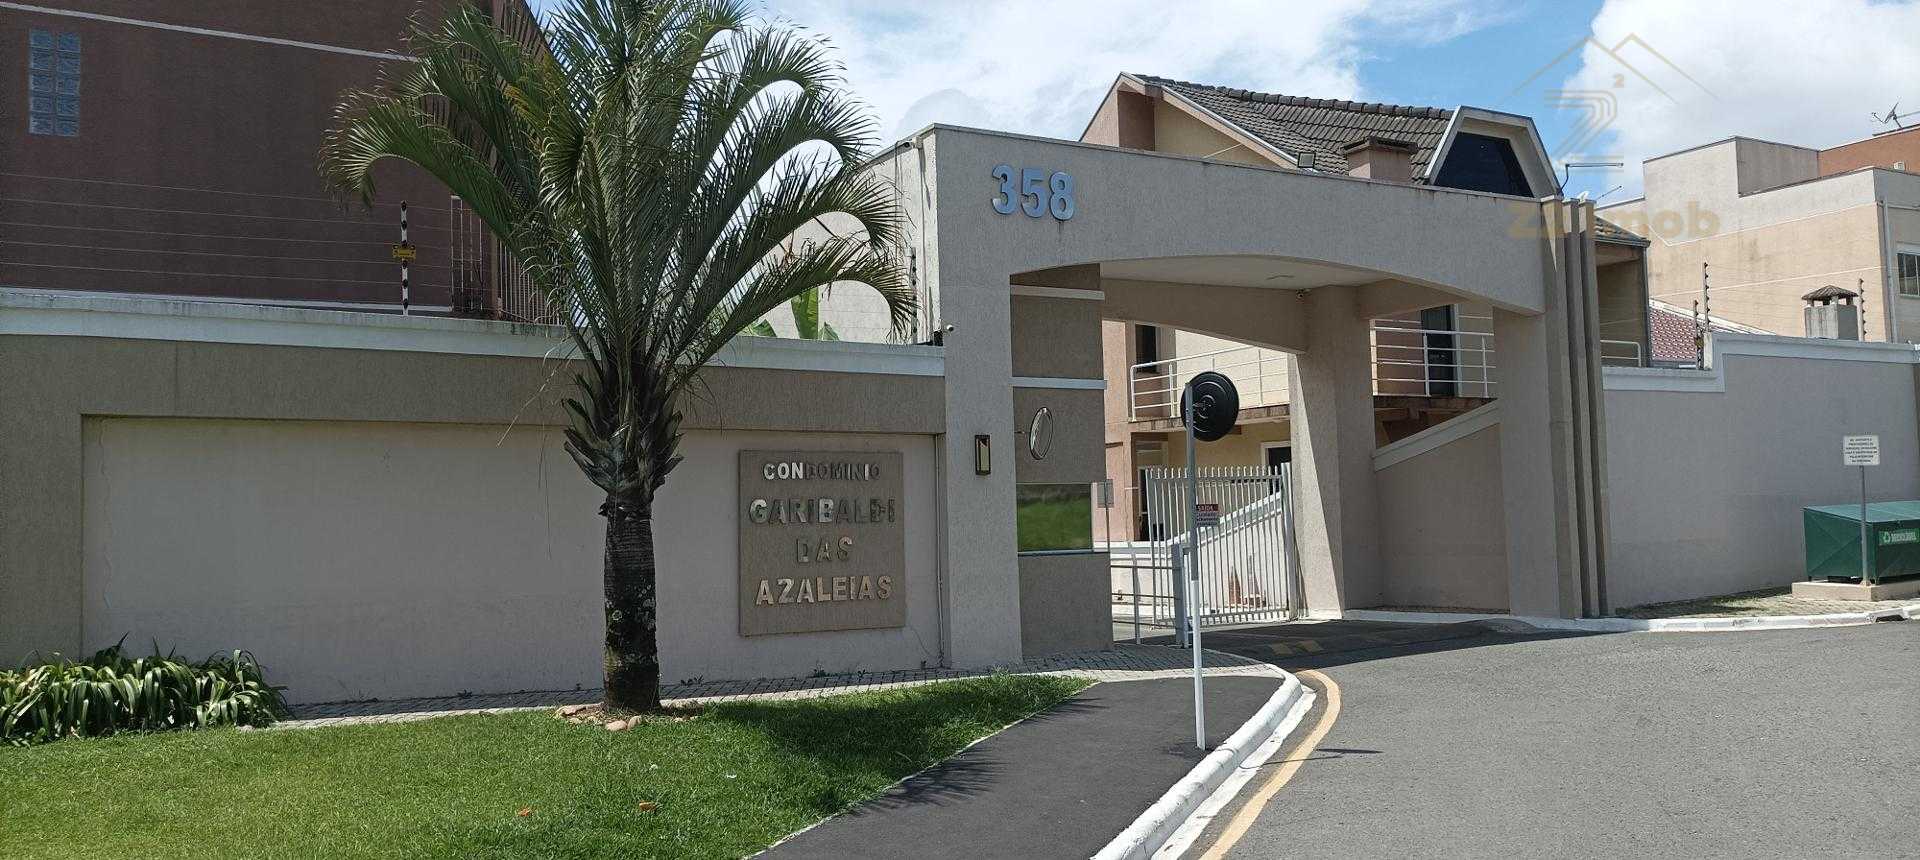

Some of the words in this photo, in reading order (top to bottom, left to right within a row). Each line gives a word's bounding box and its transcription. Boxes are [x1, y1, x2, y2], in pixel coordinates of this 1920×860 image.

[991, 164, 1075, 221] 358
[750, 499, 896, 524] GARIBALDI
[797, 536, 853, 563] DAS
[756, 576, 893, 605] AZALEIAS
